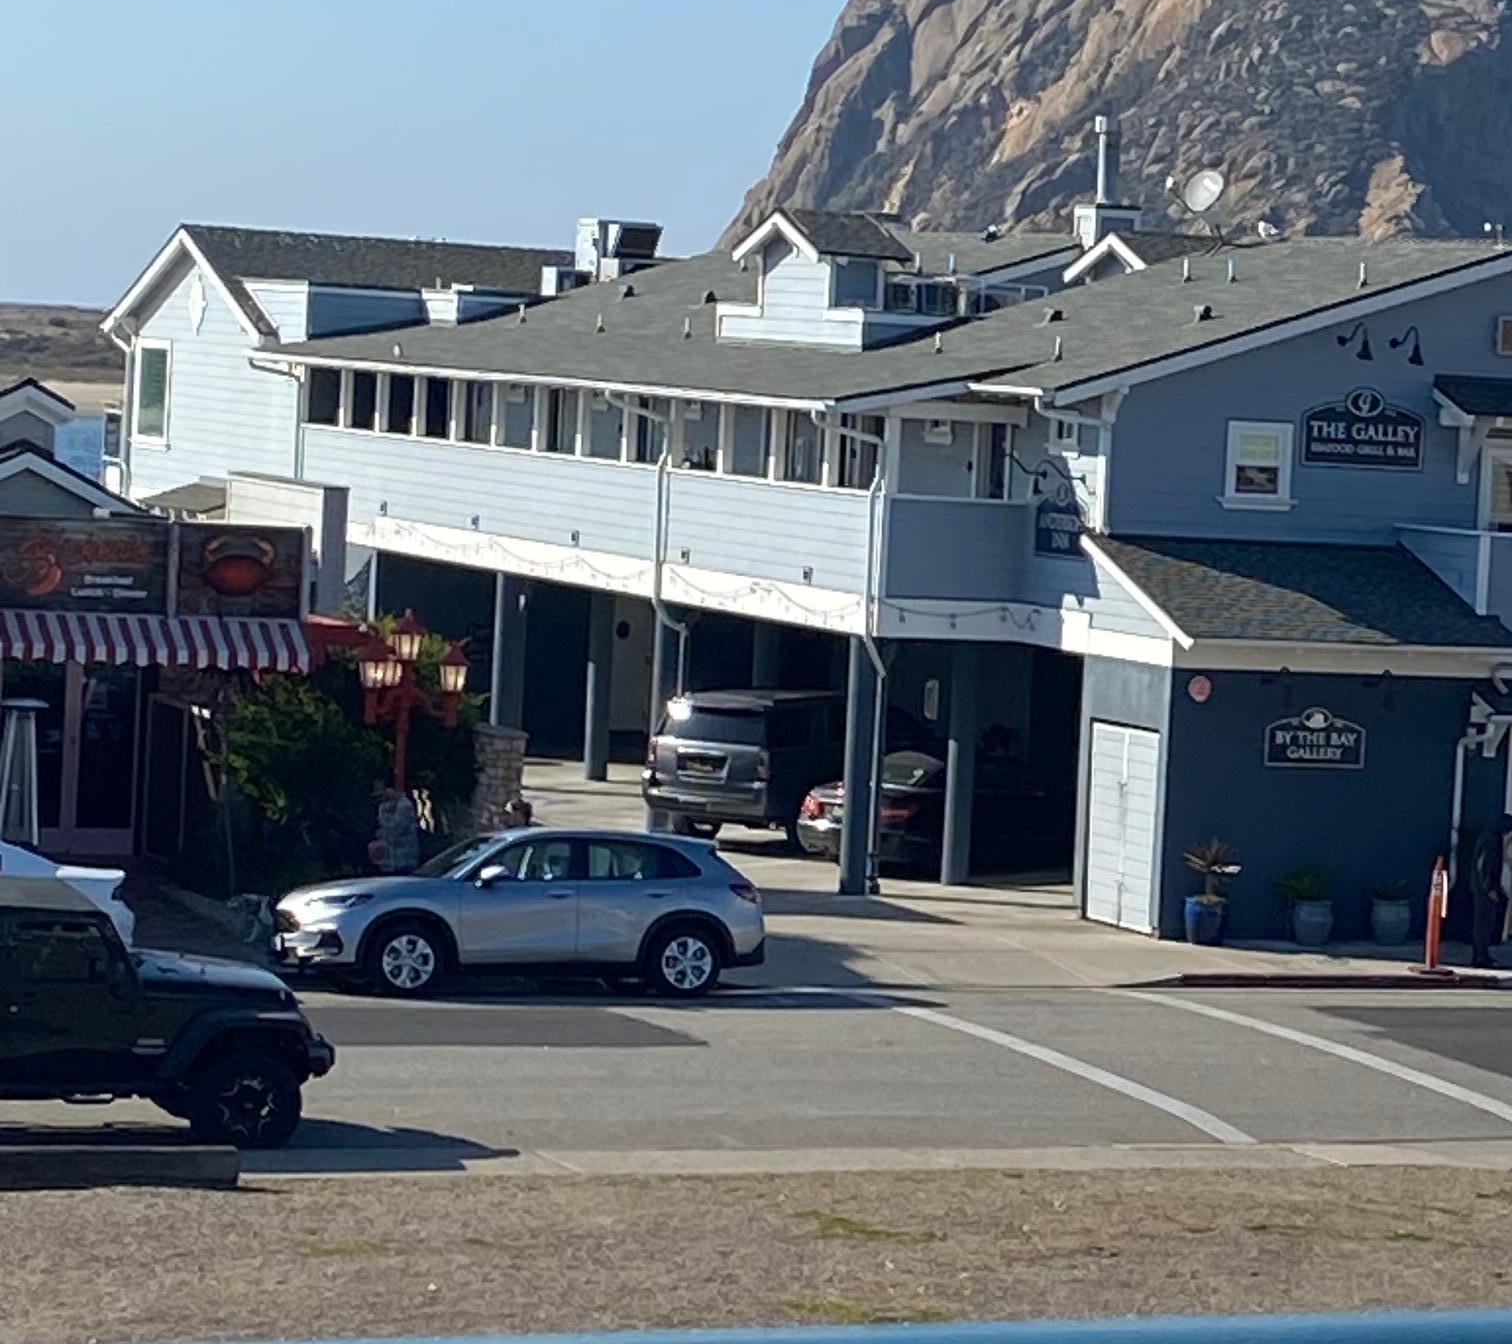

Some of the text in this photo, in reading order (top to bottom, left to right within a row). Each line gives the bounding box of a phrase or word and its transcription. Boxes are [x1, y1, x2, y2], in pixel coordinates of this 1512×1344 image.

[1309, 420, 1419, 443] THE GALLEY
[1275, 730, 1358, 747] BY THE BAY
[1286, 746, 1343, 760] GALLERY
